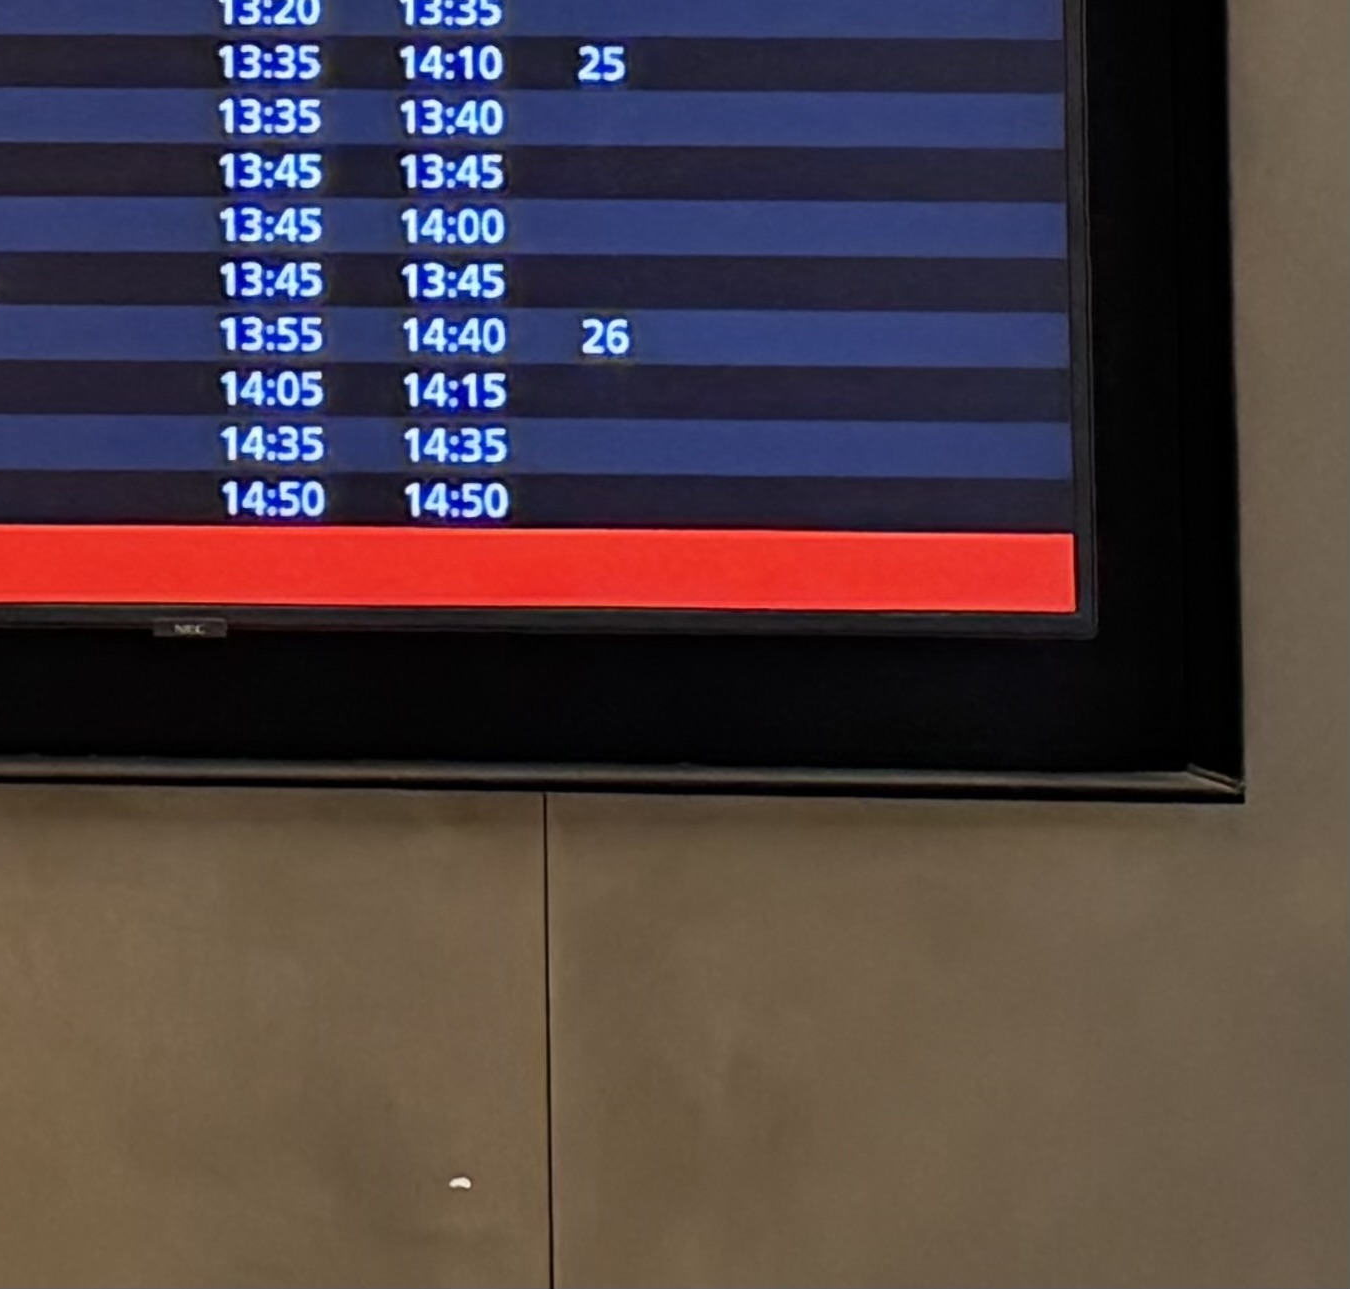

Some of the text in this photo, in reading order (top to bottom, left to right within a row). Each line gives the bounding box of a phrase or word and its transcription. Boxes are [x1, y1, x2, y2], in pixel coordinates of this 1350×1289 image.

[219, 260, 324, 298] 13:45
[400, 261, 506, 300] 13:45
[219, 315, 324, 353] 13:55
[402, 316, 507, 355] 14:40
[581, 317, 631, 356] 26
[221, 480, 326, 518] 14:50
[403, 481, 510, 519] 14:50
